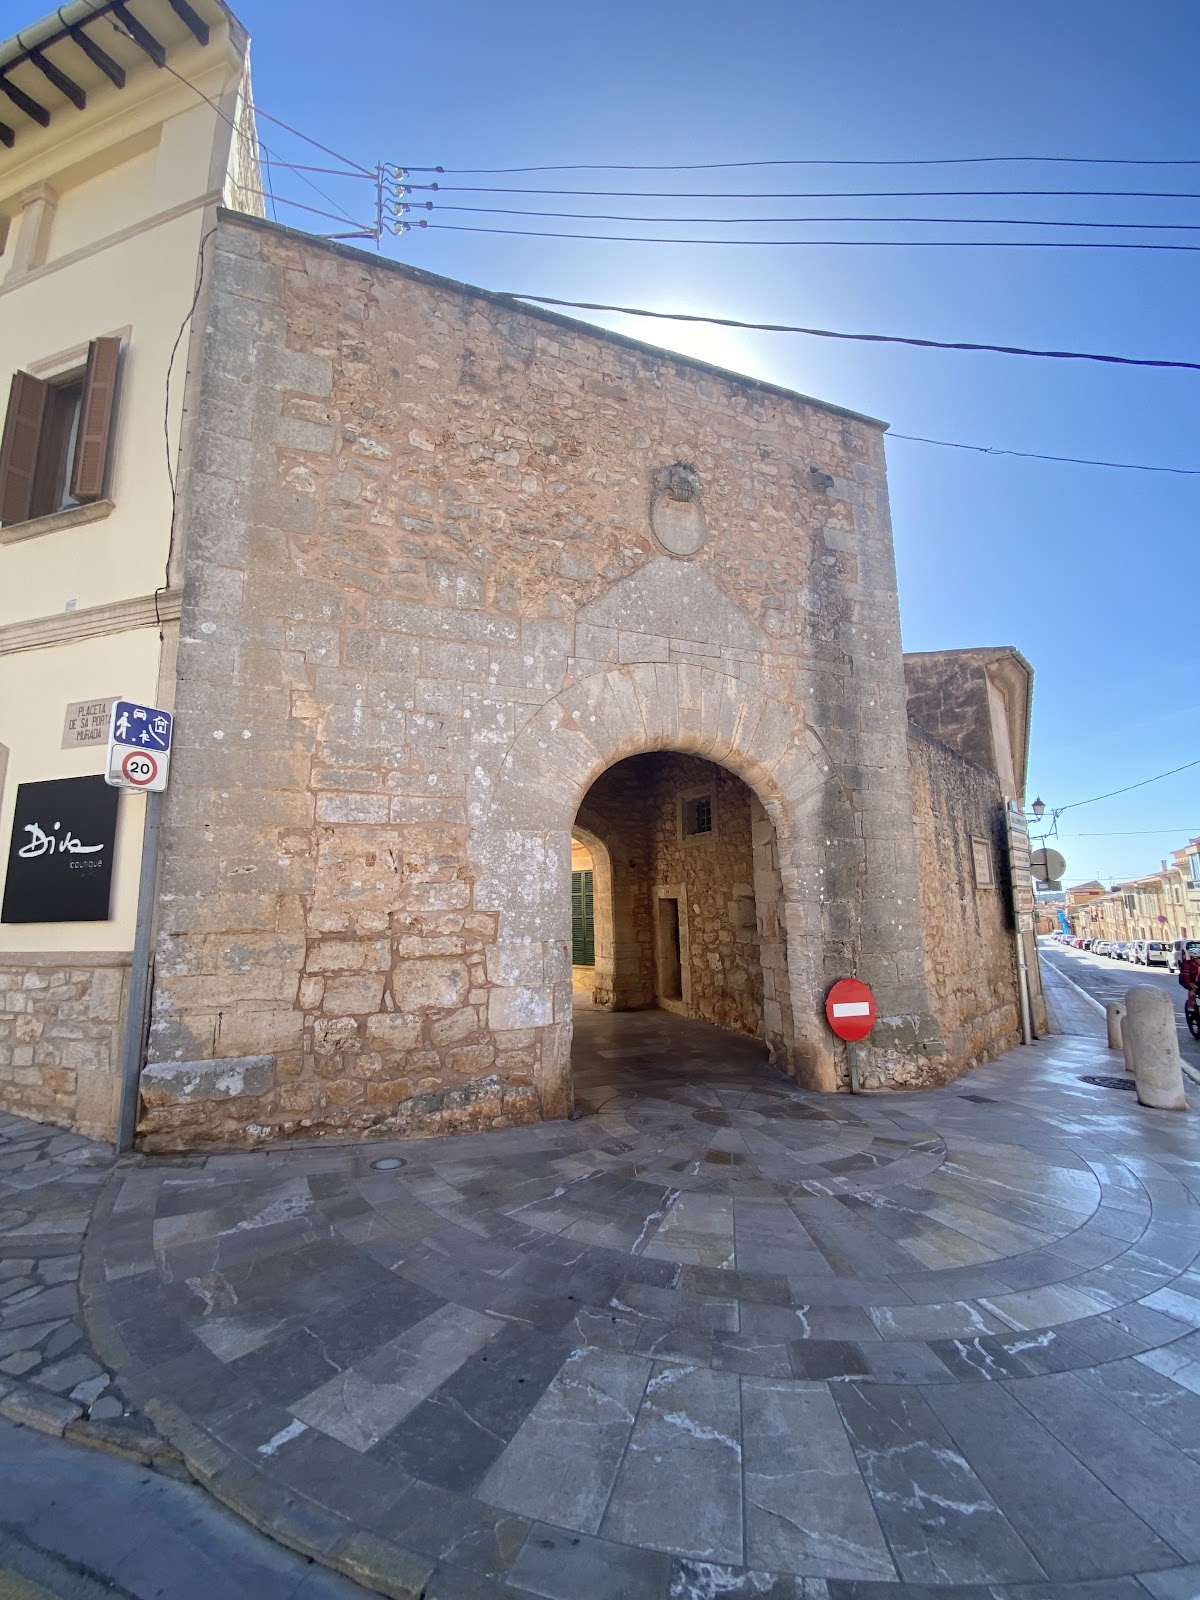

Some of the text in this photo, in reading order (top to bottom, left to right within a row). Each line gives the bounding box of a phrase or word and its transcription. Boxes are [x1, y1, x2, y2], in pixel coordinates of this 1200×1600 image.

[78, 703, 106, 717] PLACETA
[69, 719, 77, 730] DE
[80, 717, 89, 728] SA
[76, 728, 102, 741] MURADA
[130, 761, 150, 775] 20
